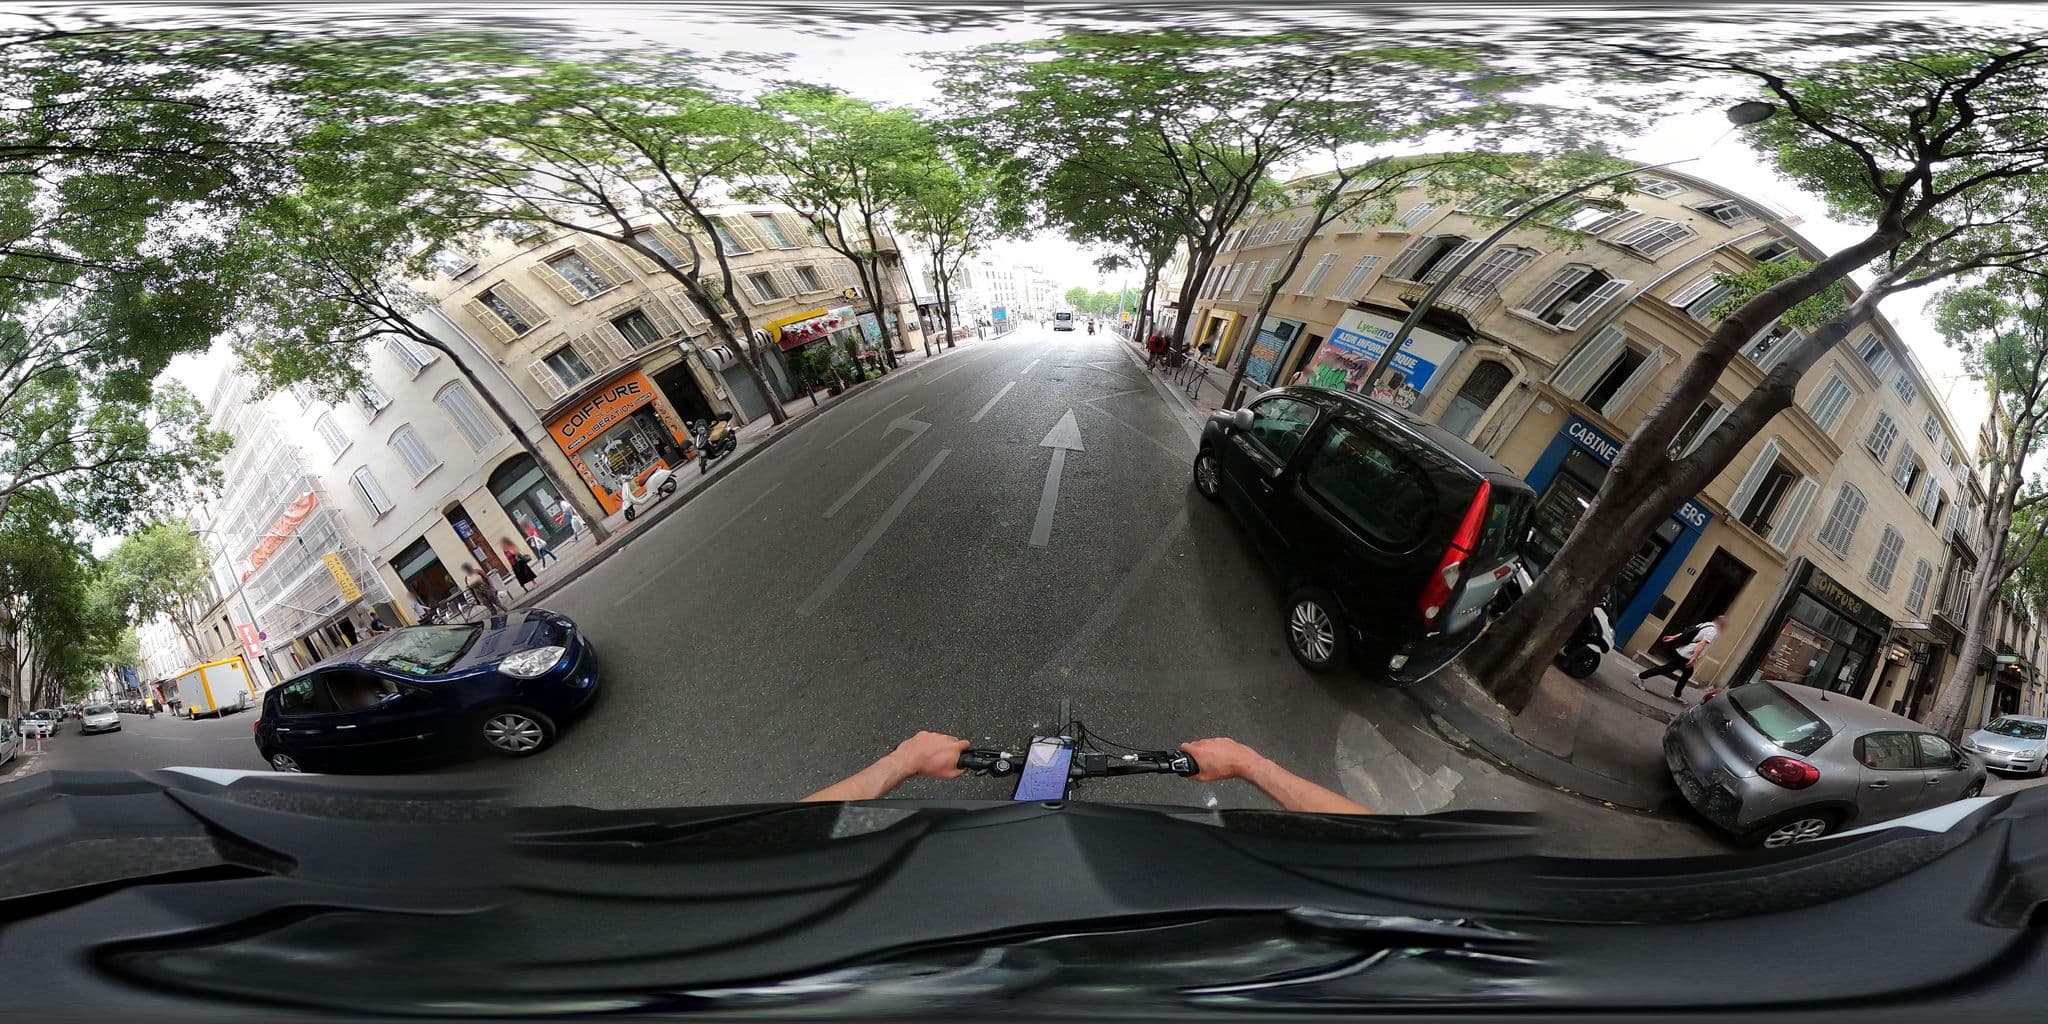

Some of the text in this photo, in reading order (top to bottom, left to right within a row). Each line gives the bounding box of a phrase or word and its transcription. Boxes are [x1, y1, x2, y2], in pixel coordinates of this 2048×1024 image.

[1357, 320, 1413, 347] Lycamoe
[1357, 337, 1418, 369] INFORMIQUE
[562, 381, 641, 437] COIFFURE
[587, 402, 634, 437] LIBERATION
[1568, 422, 1620, 465] CABINET
[1680, 502, 1706, 527] ERS
